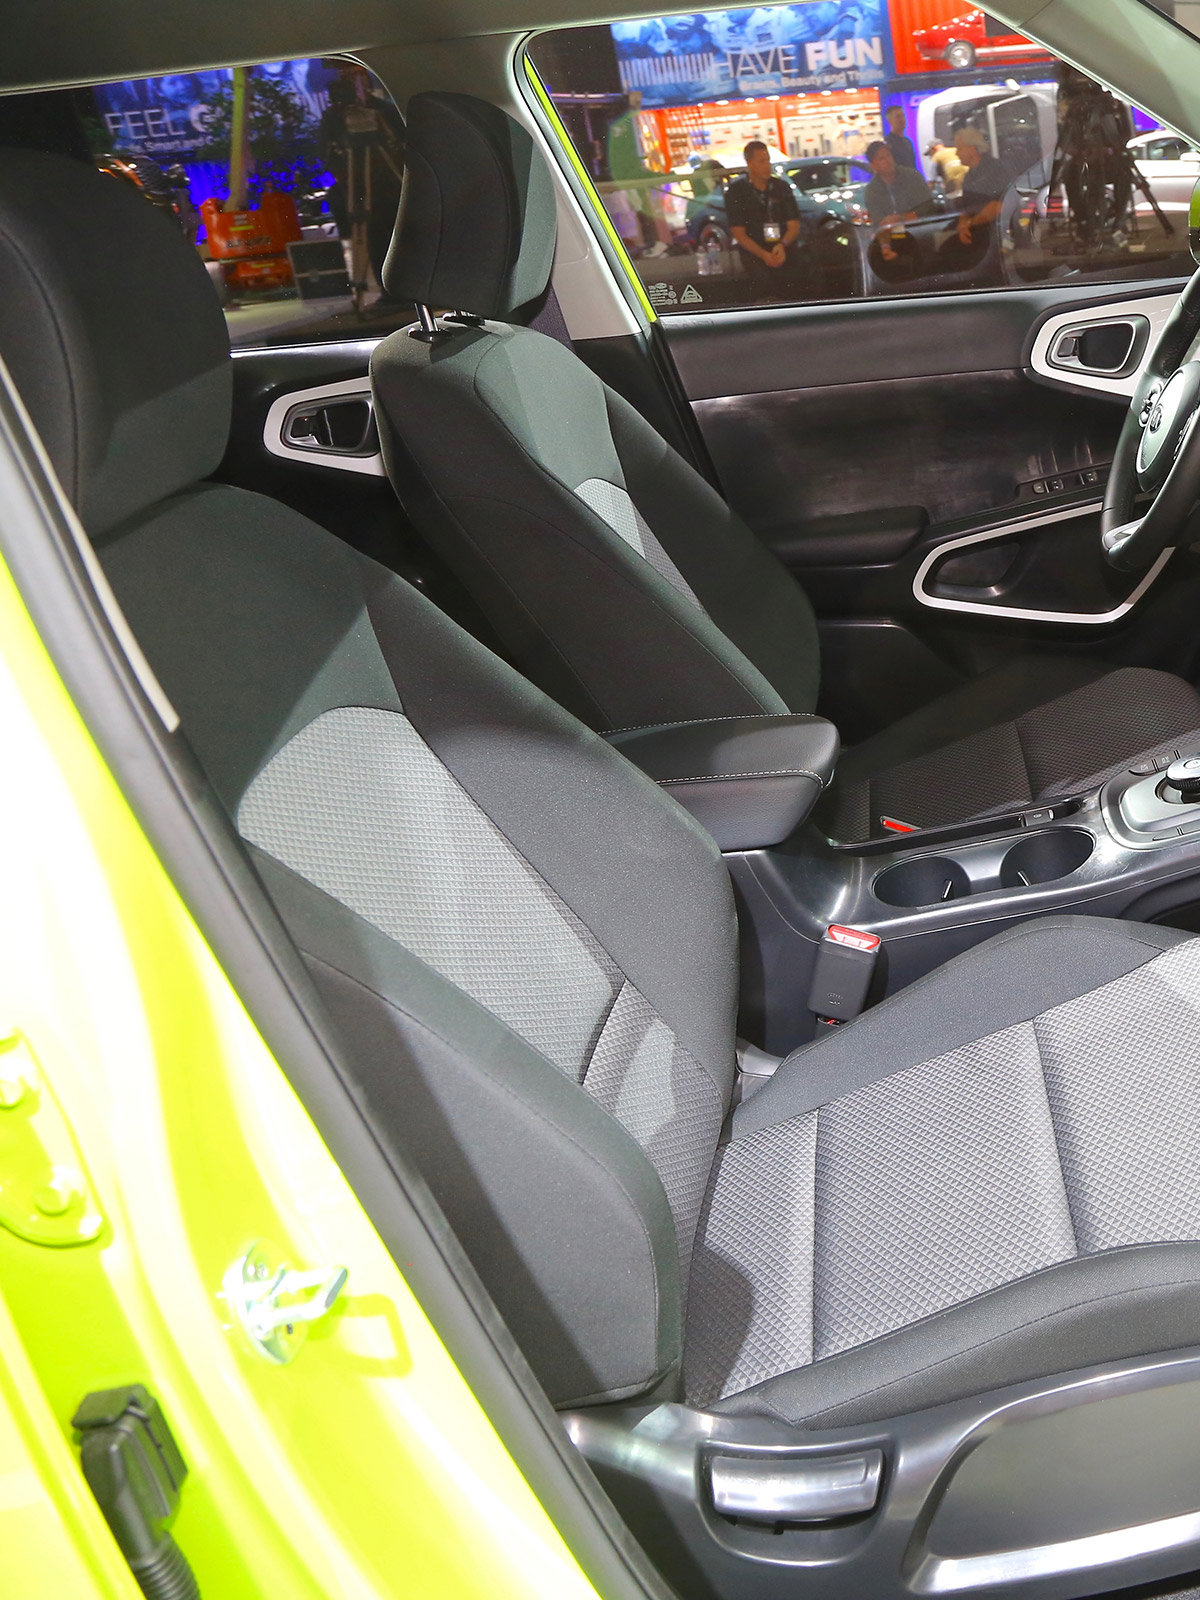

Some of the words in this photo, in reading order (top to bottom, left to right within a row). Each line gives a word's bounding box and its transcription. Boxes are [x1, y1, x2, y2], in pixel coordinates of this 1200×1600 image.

[711, 44, 799, 78] HAVE
[804, 36, 884, 71] FUN
[104, 108, 187, 139] FEEL
